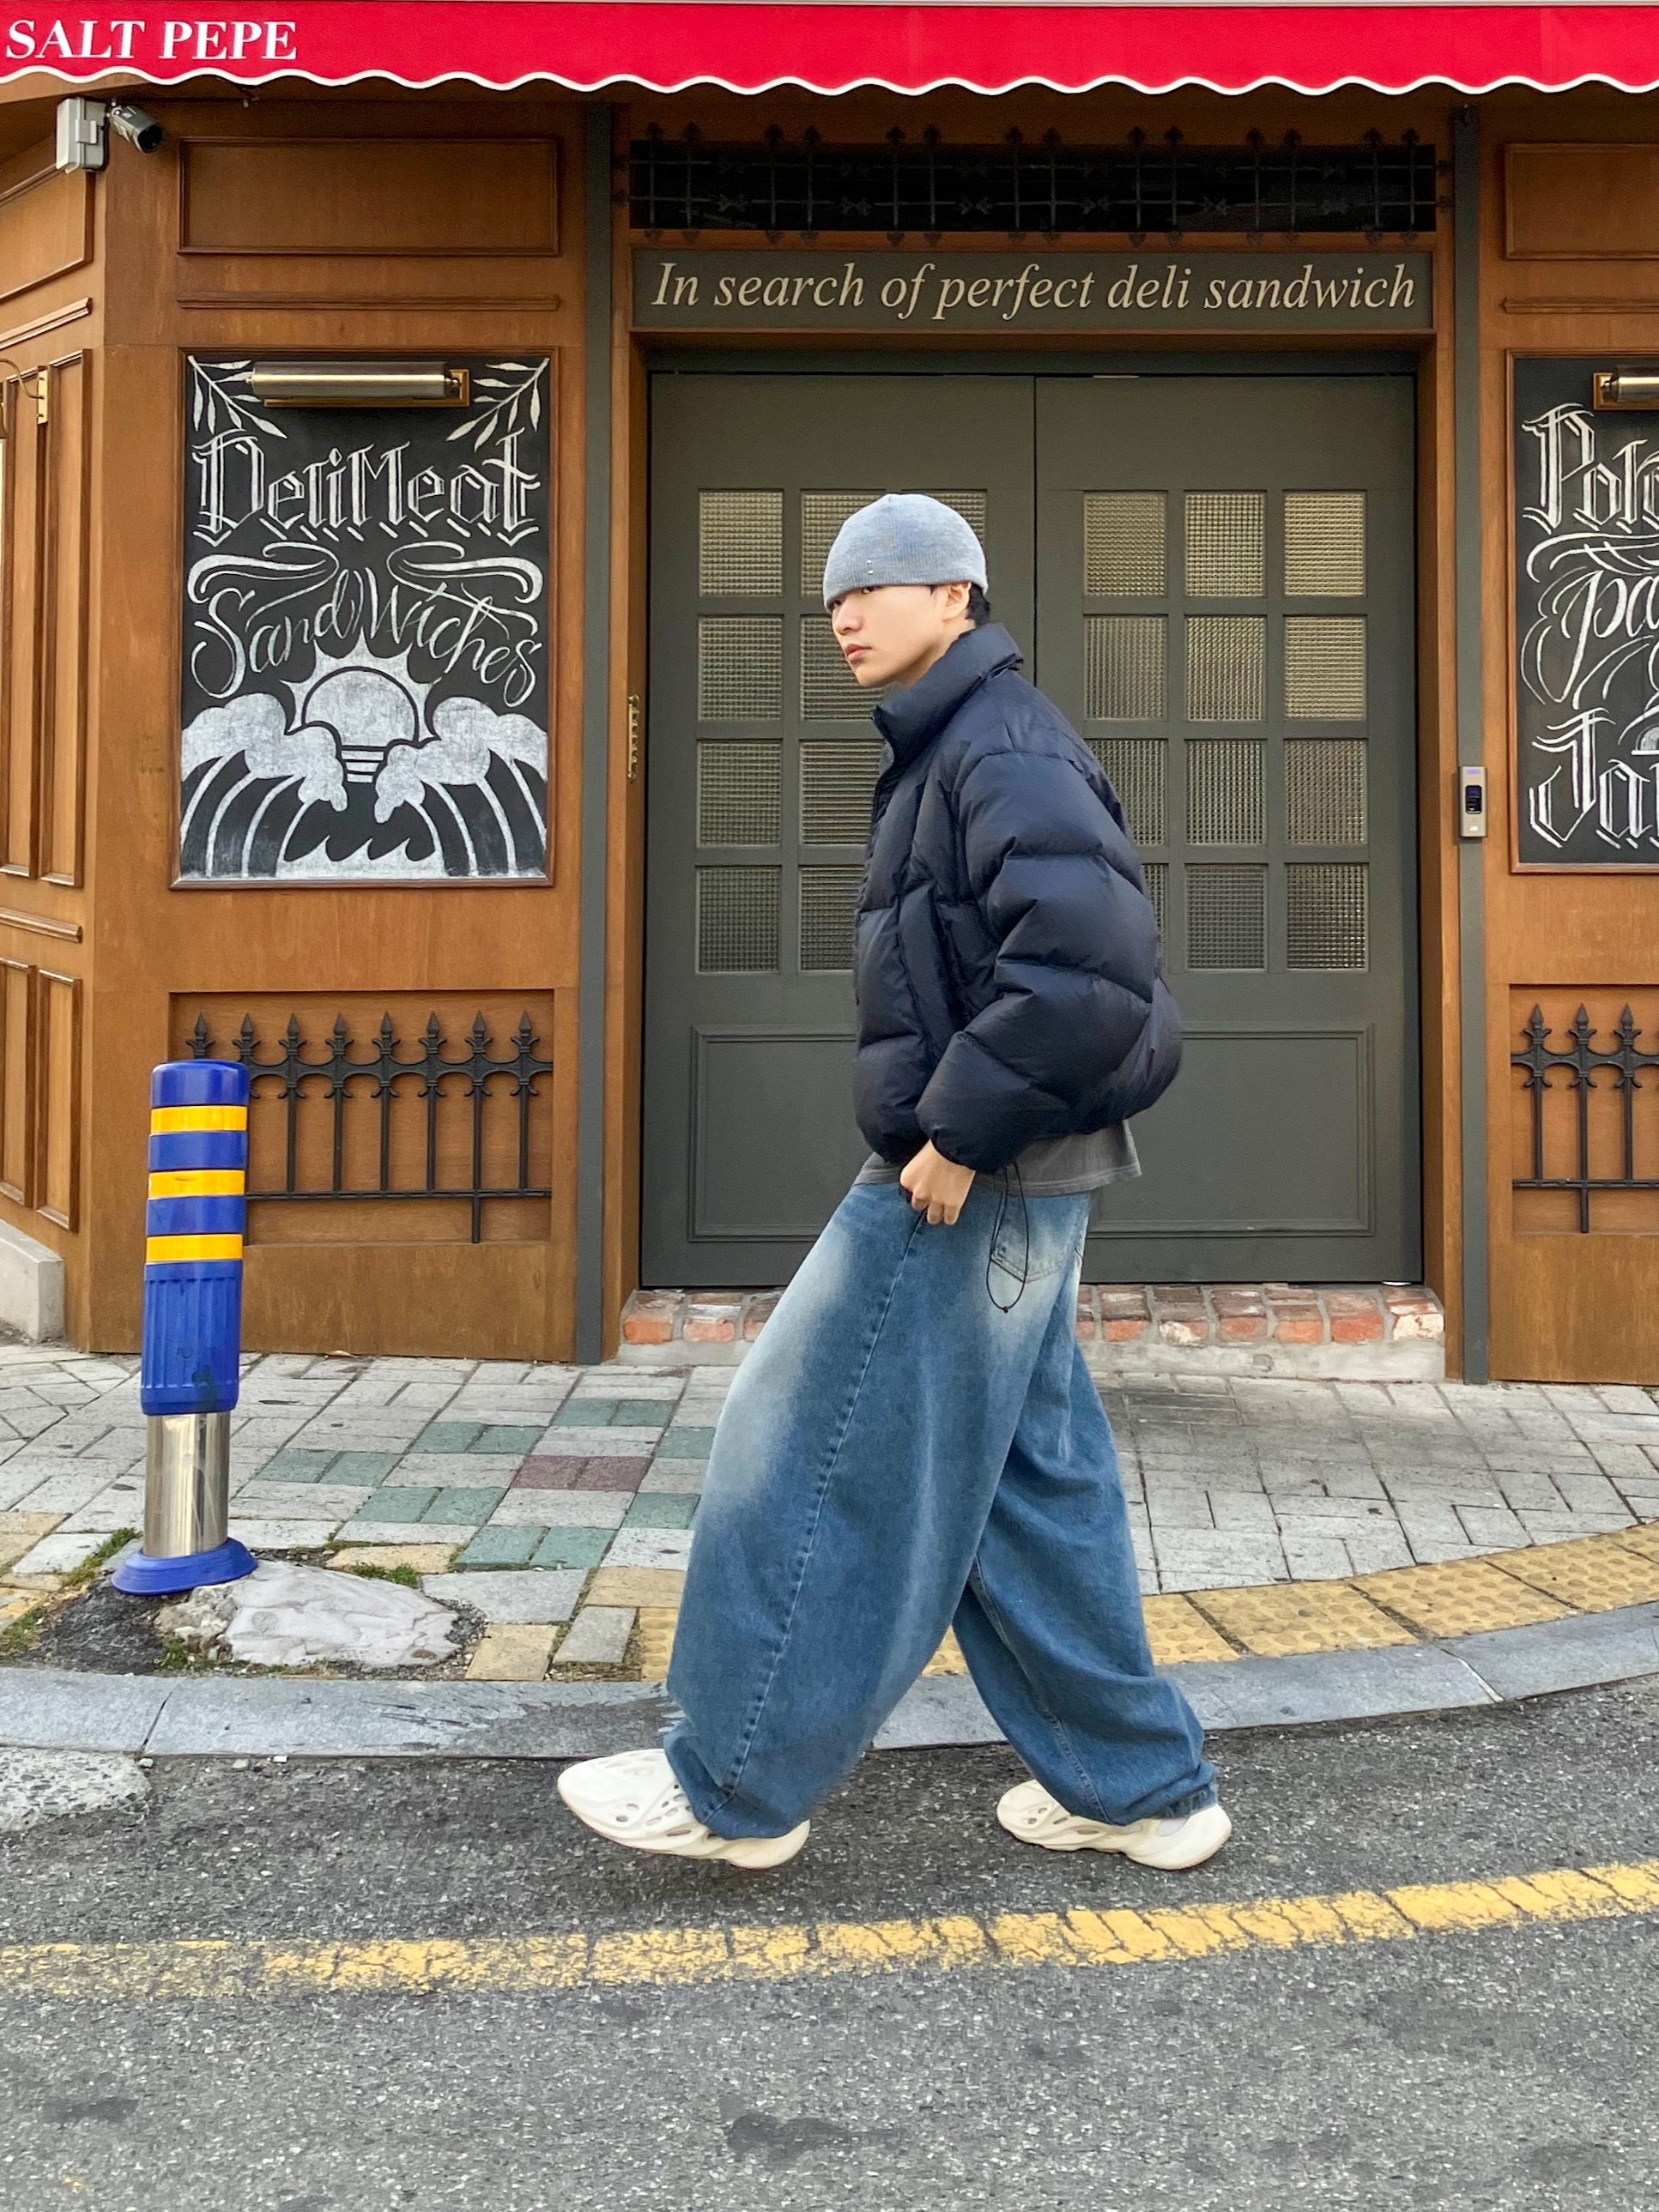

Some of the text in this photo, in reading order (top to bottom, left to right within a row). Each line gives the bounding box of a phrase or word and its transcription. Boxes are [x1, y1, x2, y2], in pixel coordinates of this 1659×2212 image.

[7, 19, 297, 60] SALT PEPE
[651, 263, 1414, 321] In search of perfect deli sandwich
